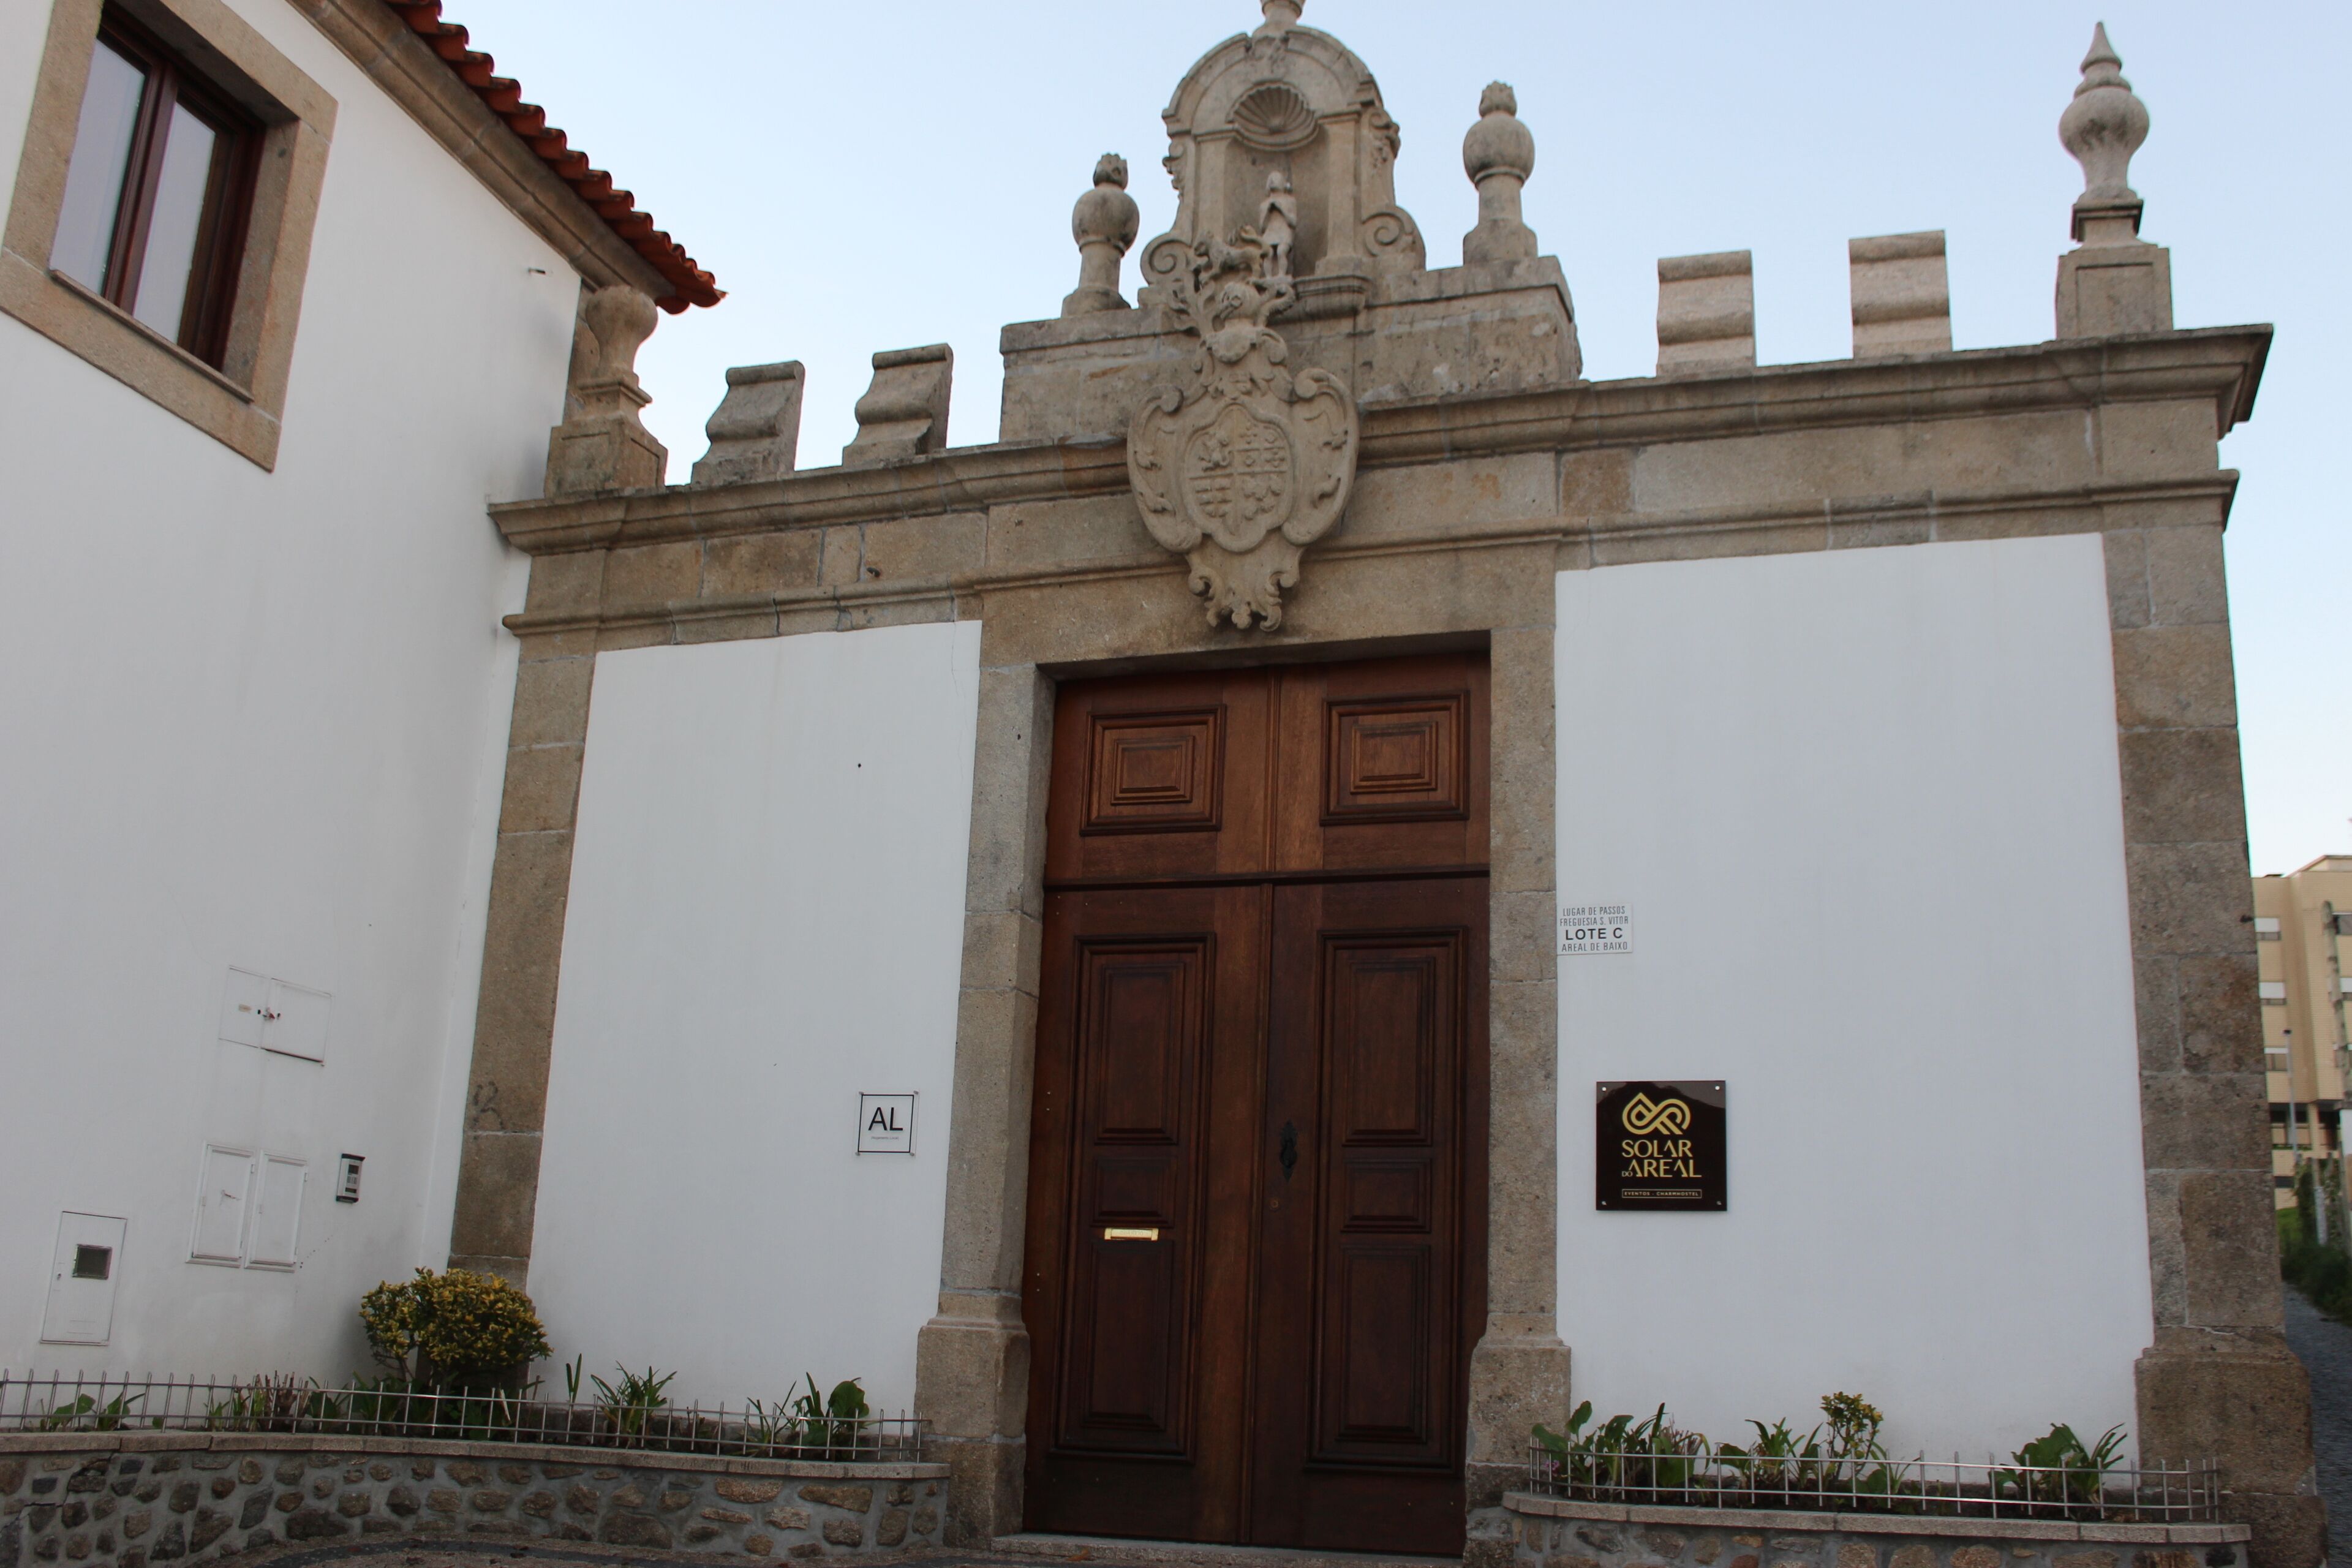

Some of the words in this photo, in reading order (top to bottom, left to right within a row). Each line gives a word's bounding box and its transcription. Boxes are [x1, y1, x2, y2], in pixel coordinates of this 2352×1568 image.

[1563, 908, 1585, 916] LUGAR
[1600, 906, 1625, 914] PASSOS
[1560, 918, 1597, 926] FREGUESIA
[1566, 928, 1607, 940] LOTE
[1613, 927, 1623, 938] C
[1562, 943, 1587, 952] AREAL
[1591, 943, 1599, 951] DE
[1604, 941, 1627, 950] BAIXO
[868, 1107, 903, 1131] AL
[1622, 1140, 1693, 1158] SOLAR
[1629, 1159, 1702, 1177] AREAL
